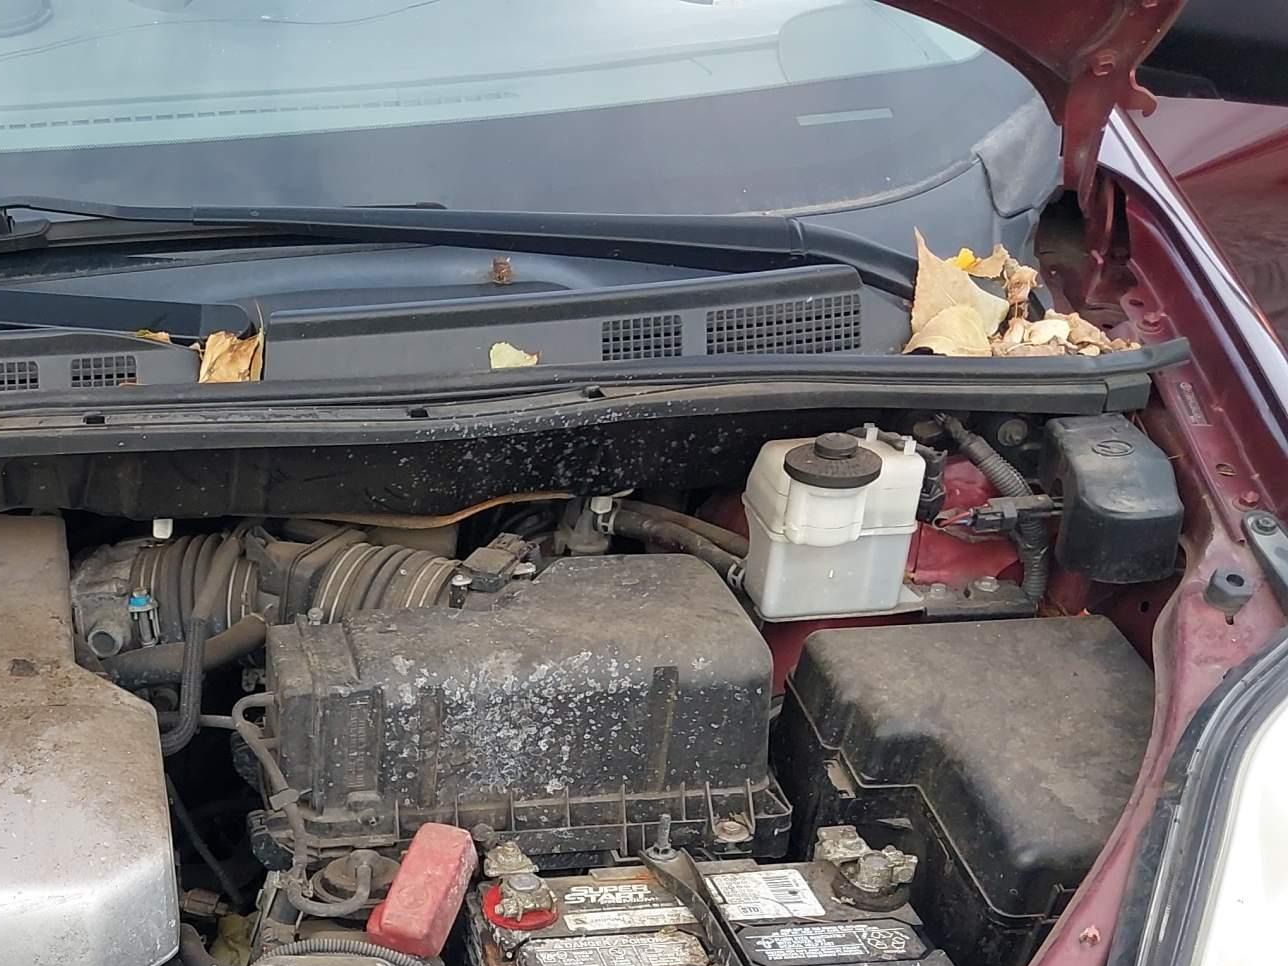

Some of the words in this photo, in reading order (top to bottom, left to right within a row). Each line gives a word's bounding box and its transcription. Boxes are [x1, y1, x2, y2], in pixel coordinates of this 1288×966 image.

[570, 884, 651, 894] SUPER
[564, 892, 645, 904] START
[566, 938, 612, 948] DANGER
